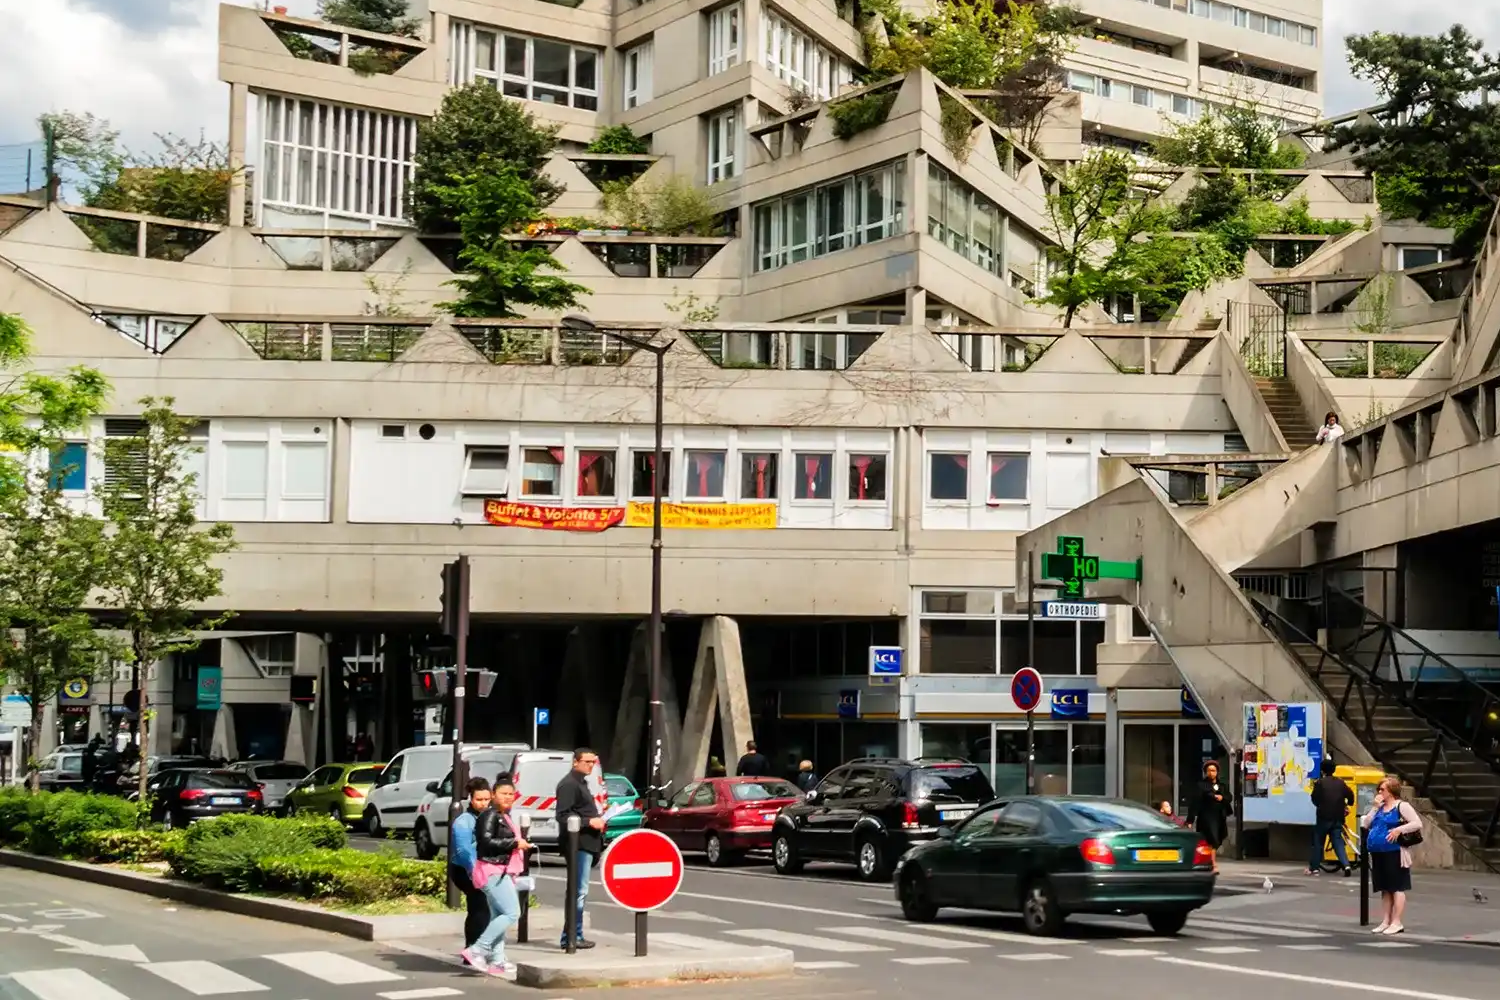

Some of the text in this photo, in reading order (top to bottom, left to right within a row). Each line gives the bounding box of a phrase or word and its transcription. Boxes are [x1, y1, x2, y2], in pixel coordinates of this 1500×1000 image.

[487, 501, 529, 518] Buffet
[532, 507, 541, 519] à
[545, 507, 596, 520] Volonté
[875, 654, 897, 663] LCL
[1053, 694, 1083, 704] LCL
[539, 712, 547, 722] P
